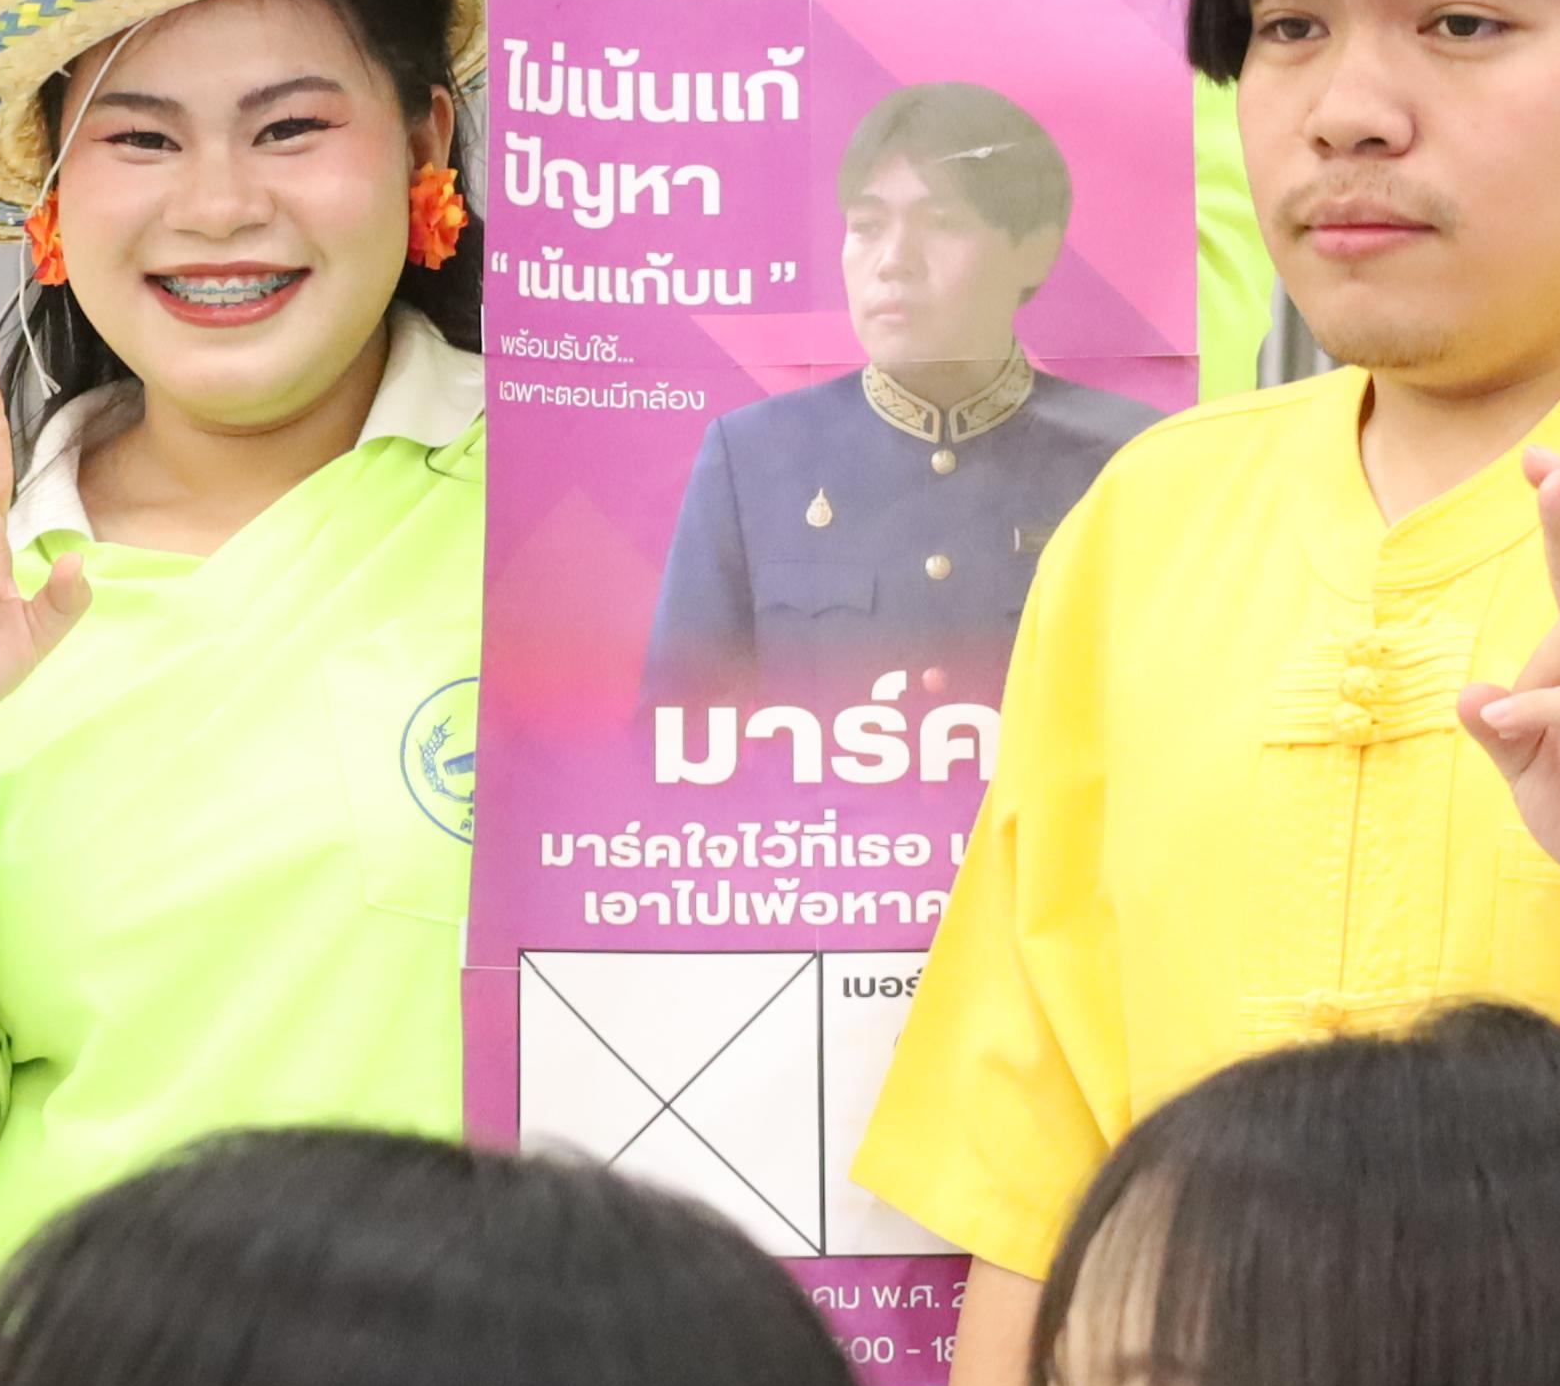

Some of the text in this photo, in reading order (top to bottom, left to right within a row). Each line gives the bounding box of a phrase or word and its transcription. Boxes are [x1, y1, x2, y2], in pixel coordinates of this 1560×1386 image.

[503, 37, 805, 123] ไม่เน้นแก้
[504, 131, 721, 230] ปัญหา
[500, 328, 635, 363] พร้อมรับใช้...
[498, 380, 706, 411] เฉพาะตอนมีกล้อง
[654, 669, 1002, 785] มาร์ค
[540, 808, 932, 869] มาร์คใจไว้ที่เธอ
[871, 1284, 941, 1310] พ.ศ.
